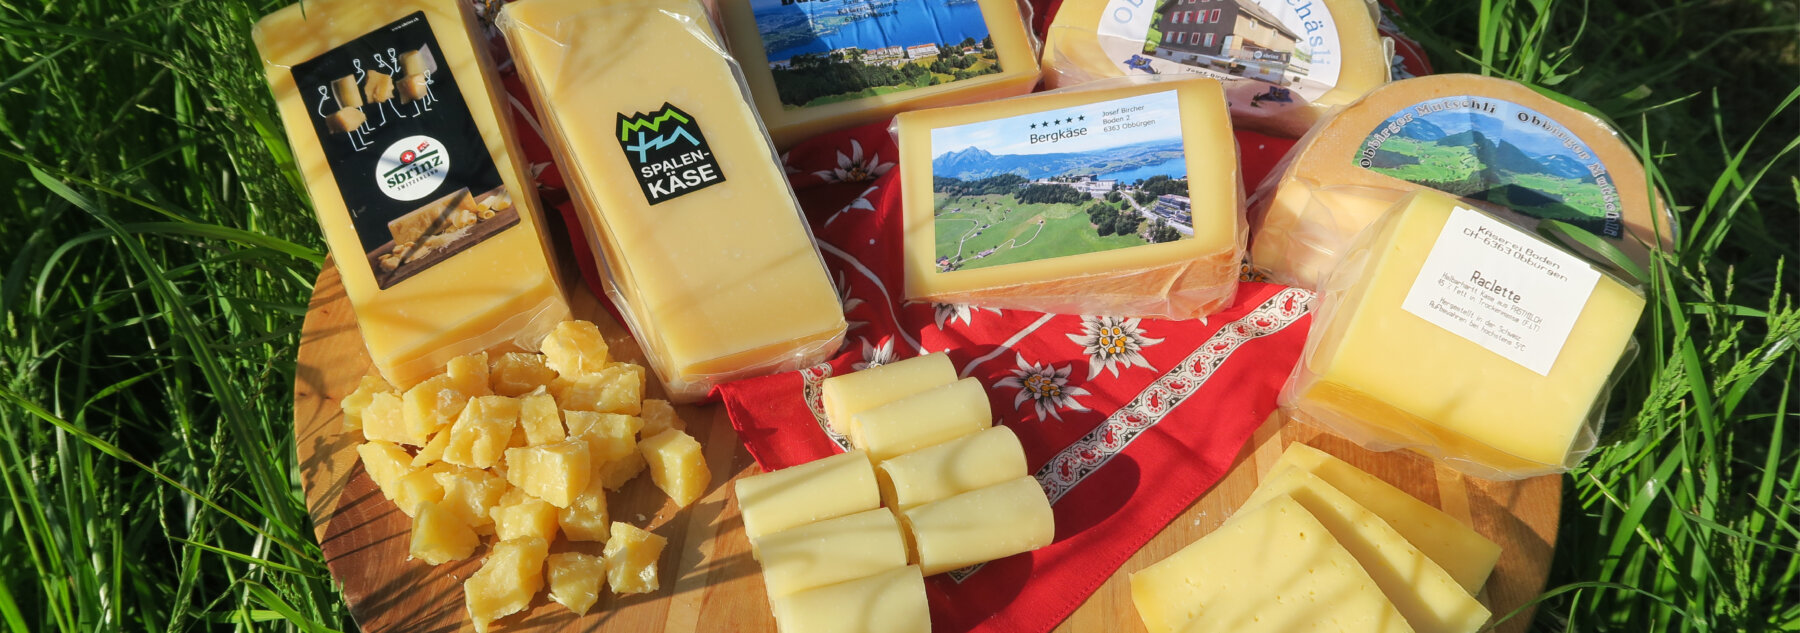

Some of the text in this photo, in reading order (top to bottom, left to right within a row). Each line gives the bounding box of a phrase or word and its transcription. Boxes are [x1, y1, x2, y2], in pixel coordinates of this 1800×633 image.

[1102, 104, 1145, 117] Josef Bircher
[1102, 116, 1124, 125] Boden
[1415, 100, 1497, 117] Mutschli
[1030, 126, 1088, 145] Bergkäse
[1103, 118, 1156, 133] 6363 Obbürgen
[386, 155, 443, 189] sbrinz
[641, 149, 710, 178] SPALEN-
[397, 168, 439, 191] SWITZERLAND
[647, 163, 718, 199] KÄSE
[1588, 162, 1620, 237] Mutschli
[1462, 227, 1512, 255] CH-6363
[1524, 248, 1561, 269] Boden
[1452, 285, 1468, 298] Fett
[1469, 270, 1522, 304] Raclette
[1428, 300, 1467, 323] Aufbewahren
[1468, 319, 1480, 329] bei
[1439, 297, 1475, 319] Hergestellt
[1484, 319, 1497, 329] der
[1498, 325, 1522, 341] Schweiz
